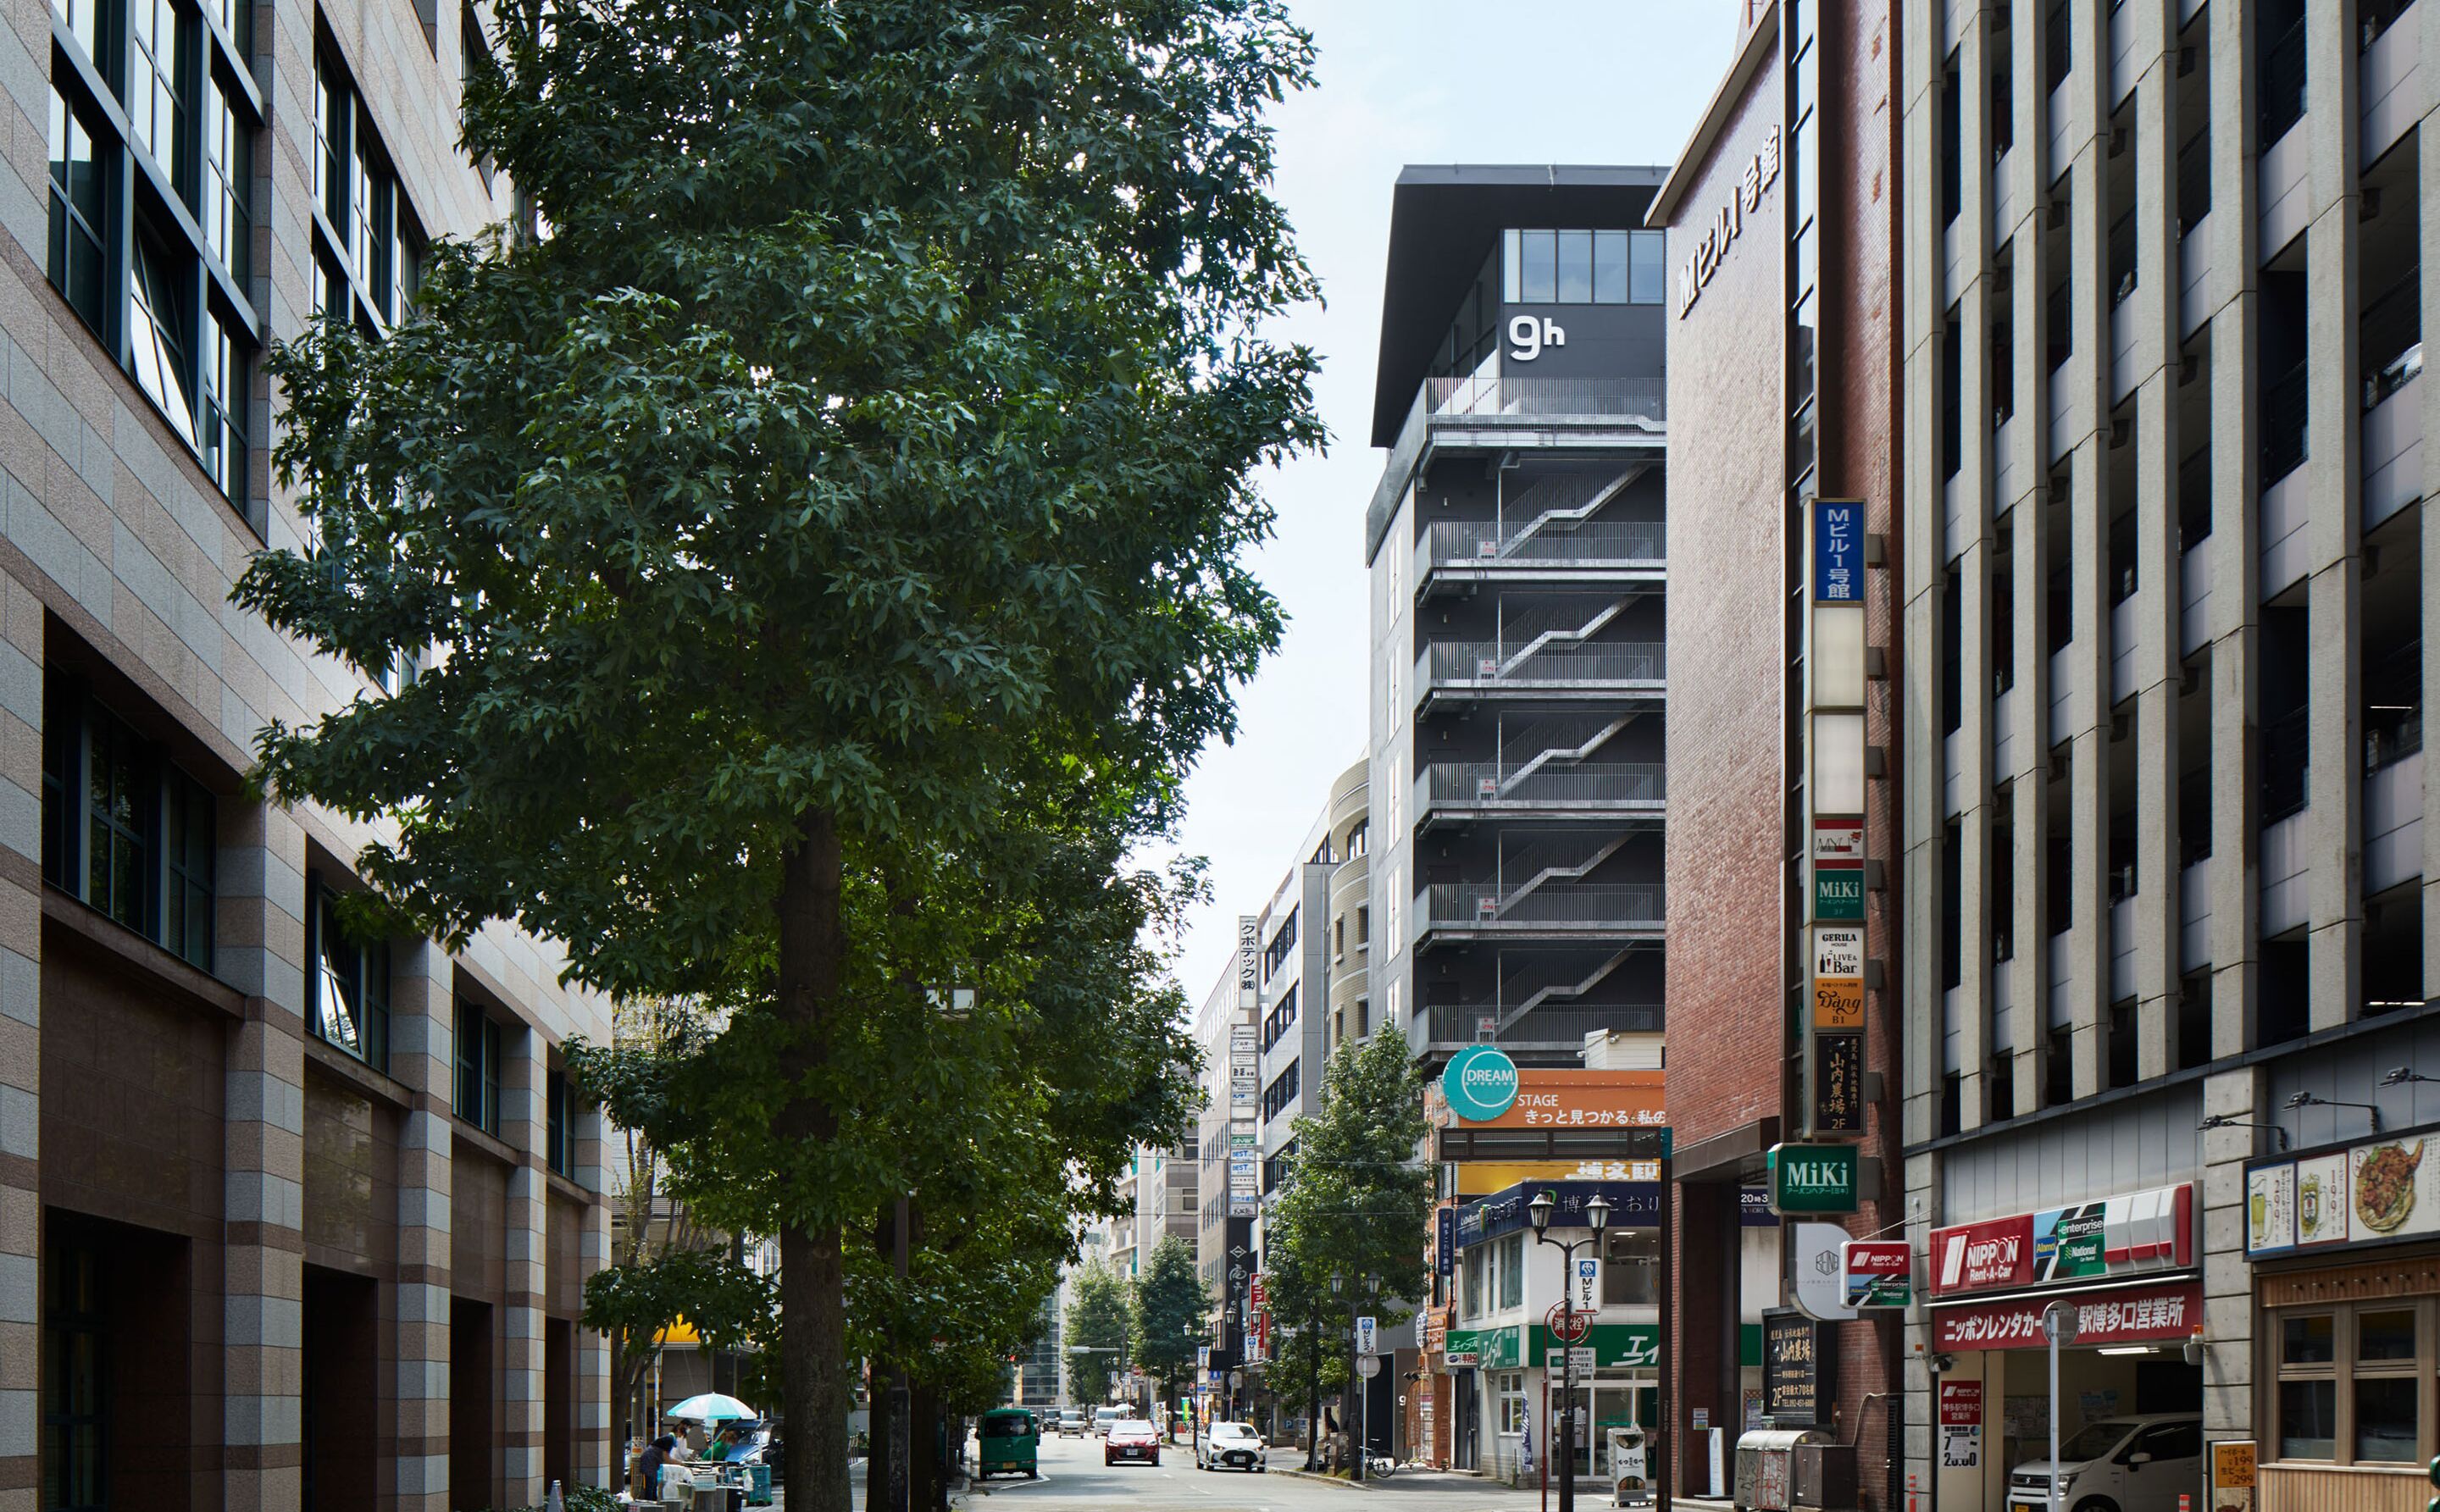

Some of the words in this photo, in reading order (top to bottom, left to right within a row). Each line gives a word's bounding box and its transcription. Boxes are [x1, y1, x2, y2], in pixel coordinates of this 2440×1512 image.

[1509, 316, 1565, 361] 9h
[1827, 508, 1850, 599] Mビル1号館
[1819, 881, 1860, 898] MiKi
[1822, 933, 1857, 942] GERILA
[1834, 961, 1857, 973] Bar
[1467, 1070, 1513, 1082] DREAM
[1517, 1095, 1559, 1107] STAGE
[1832, 1118, 1846, 1129] 2F
[1787, 1162, 1849, 1187] MiKi
[1562, 1195, 1659, 1214] 博こおり
[2059, 1219, 2103, 1235] enterprise
[1966, 1239, 2019, 1267] NIPPON
[2071, 1243, 2097, 1258] National
[2074, 1295, 2185, 1334] 駅博多口営業所
[1555, 1316, 1583, 1331] 消栓
[1772, 1388, 1782, 1406] 2F
